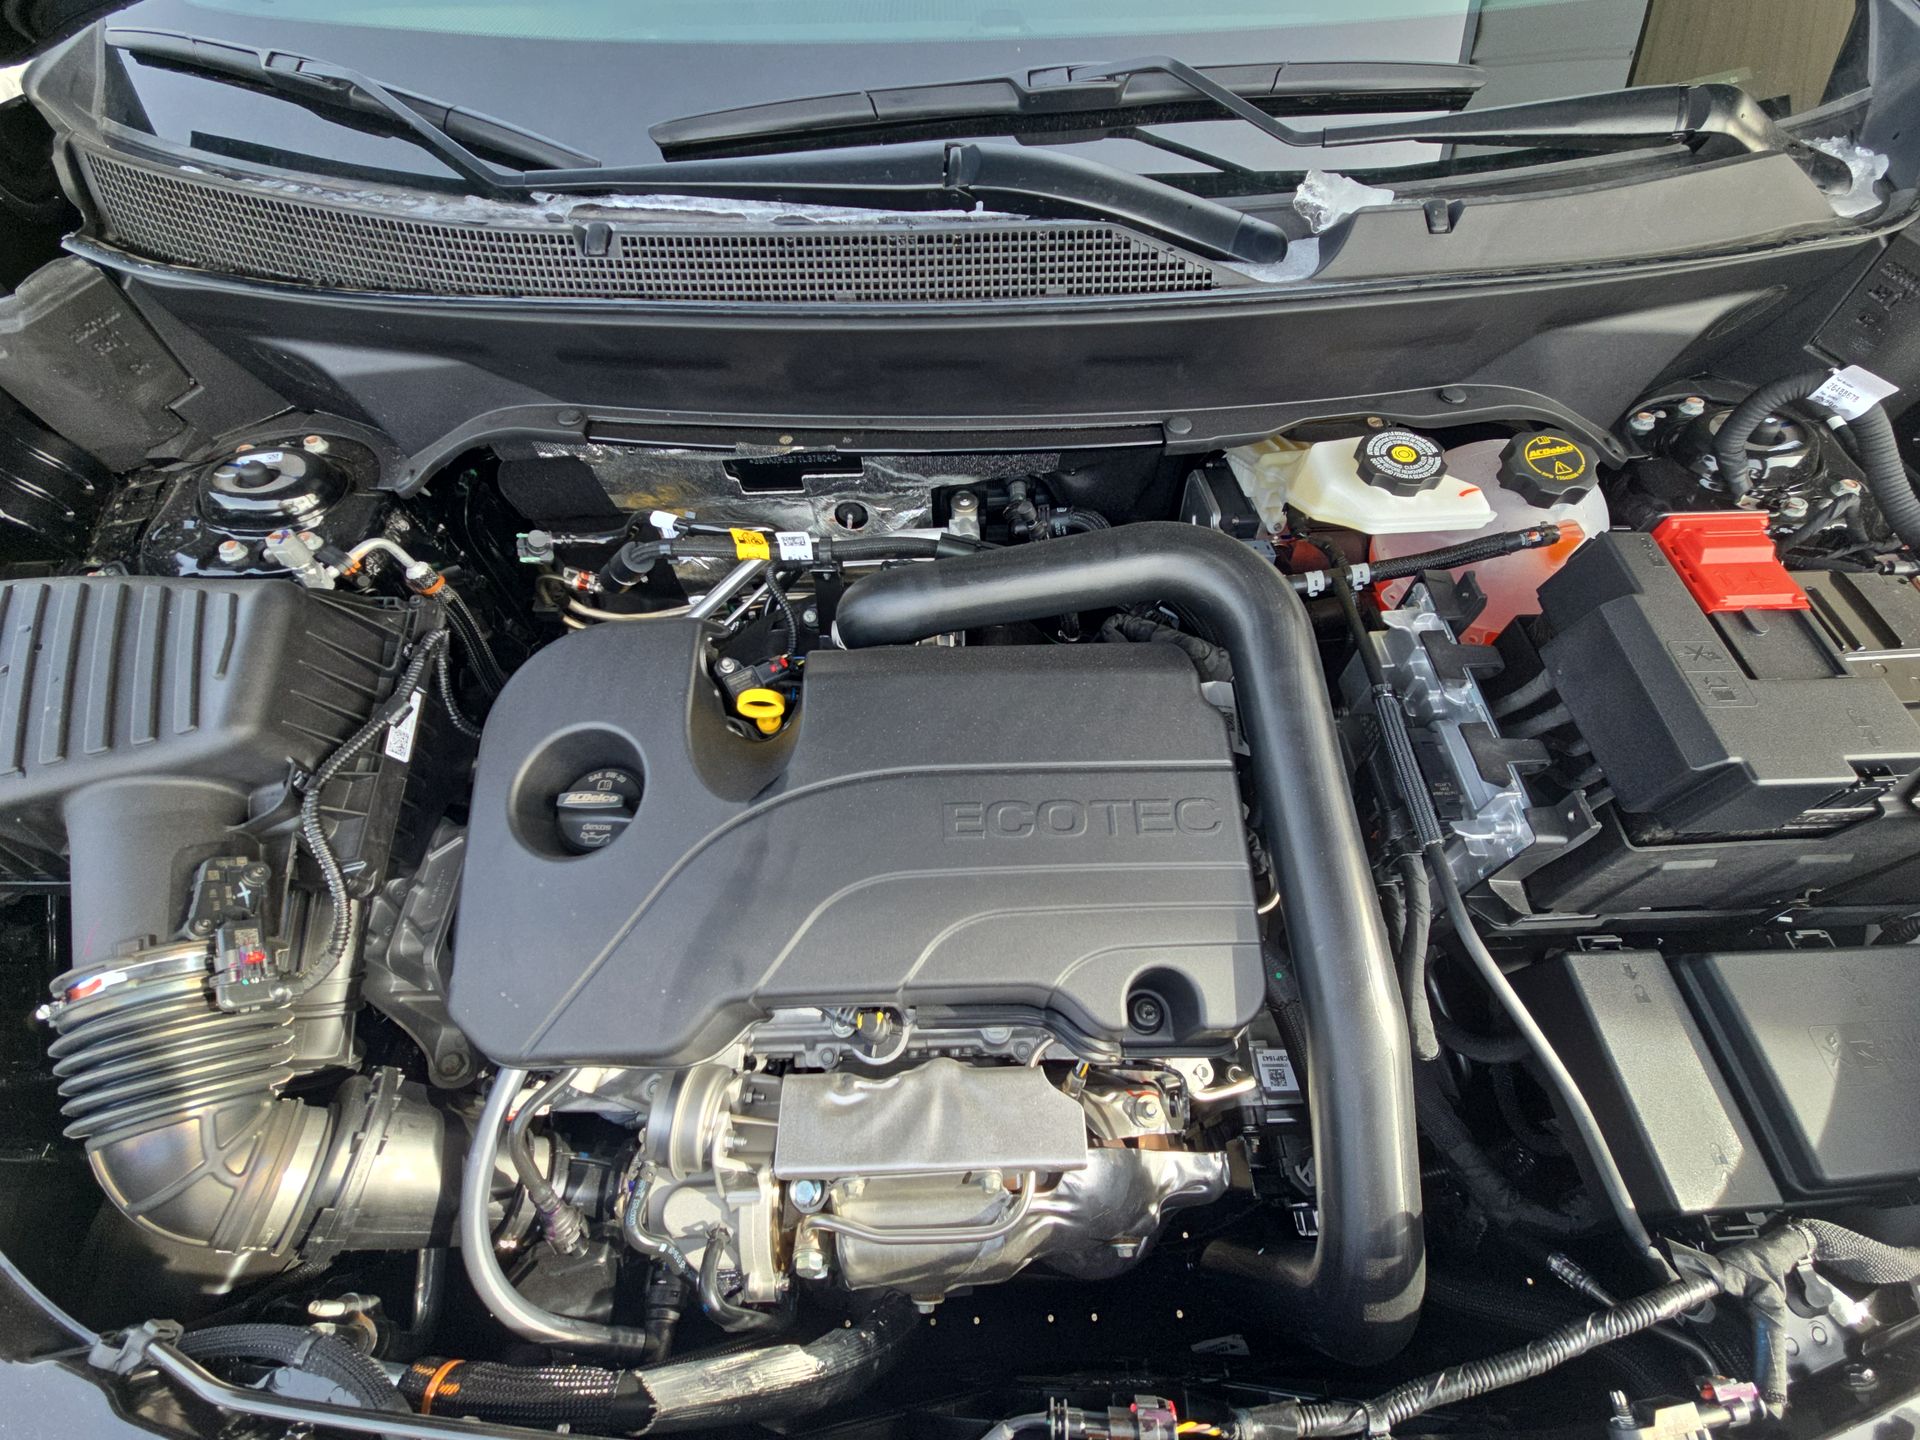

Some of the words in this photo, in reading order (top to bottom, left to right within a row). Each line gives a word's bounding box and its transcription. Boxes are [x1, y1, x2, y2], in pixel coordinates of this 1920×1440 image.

[1529, 445, 1574, 458] ACDelco
[565, 793, 619, 803] ACDelco
[943, 797, 1223, 840] ECOTEC
